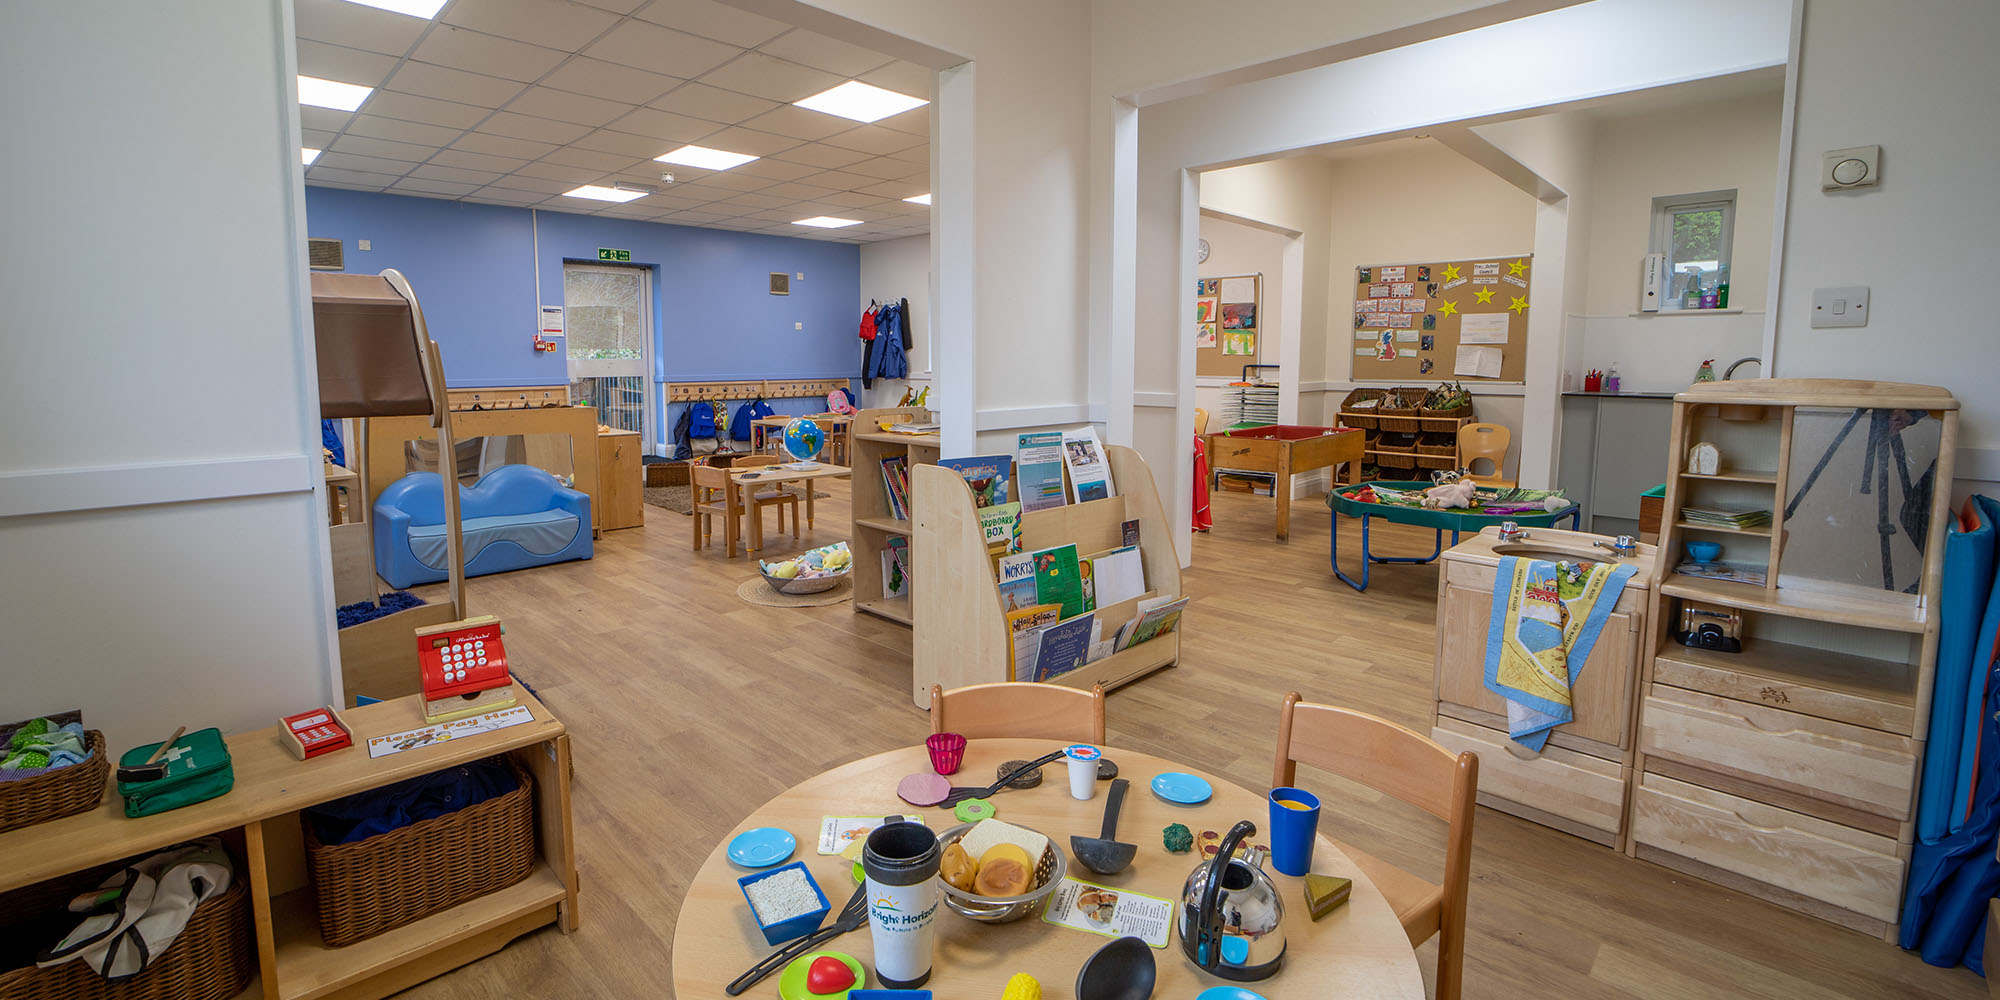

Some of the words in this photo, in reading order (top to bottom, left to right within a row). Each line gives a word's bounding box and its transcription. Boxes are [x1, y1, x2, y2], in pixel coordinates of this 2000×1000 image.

[952, 463, 998, 477] Carrying
[986, 526, 1004, 538] BOX
[372, 728, 436, 746] Please
[442, 719, 478, 730] Pay
[484, 708, 526, 720] Here
[872, 906, 900, 924] Bright
